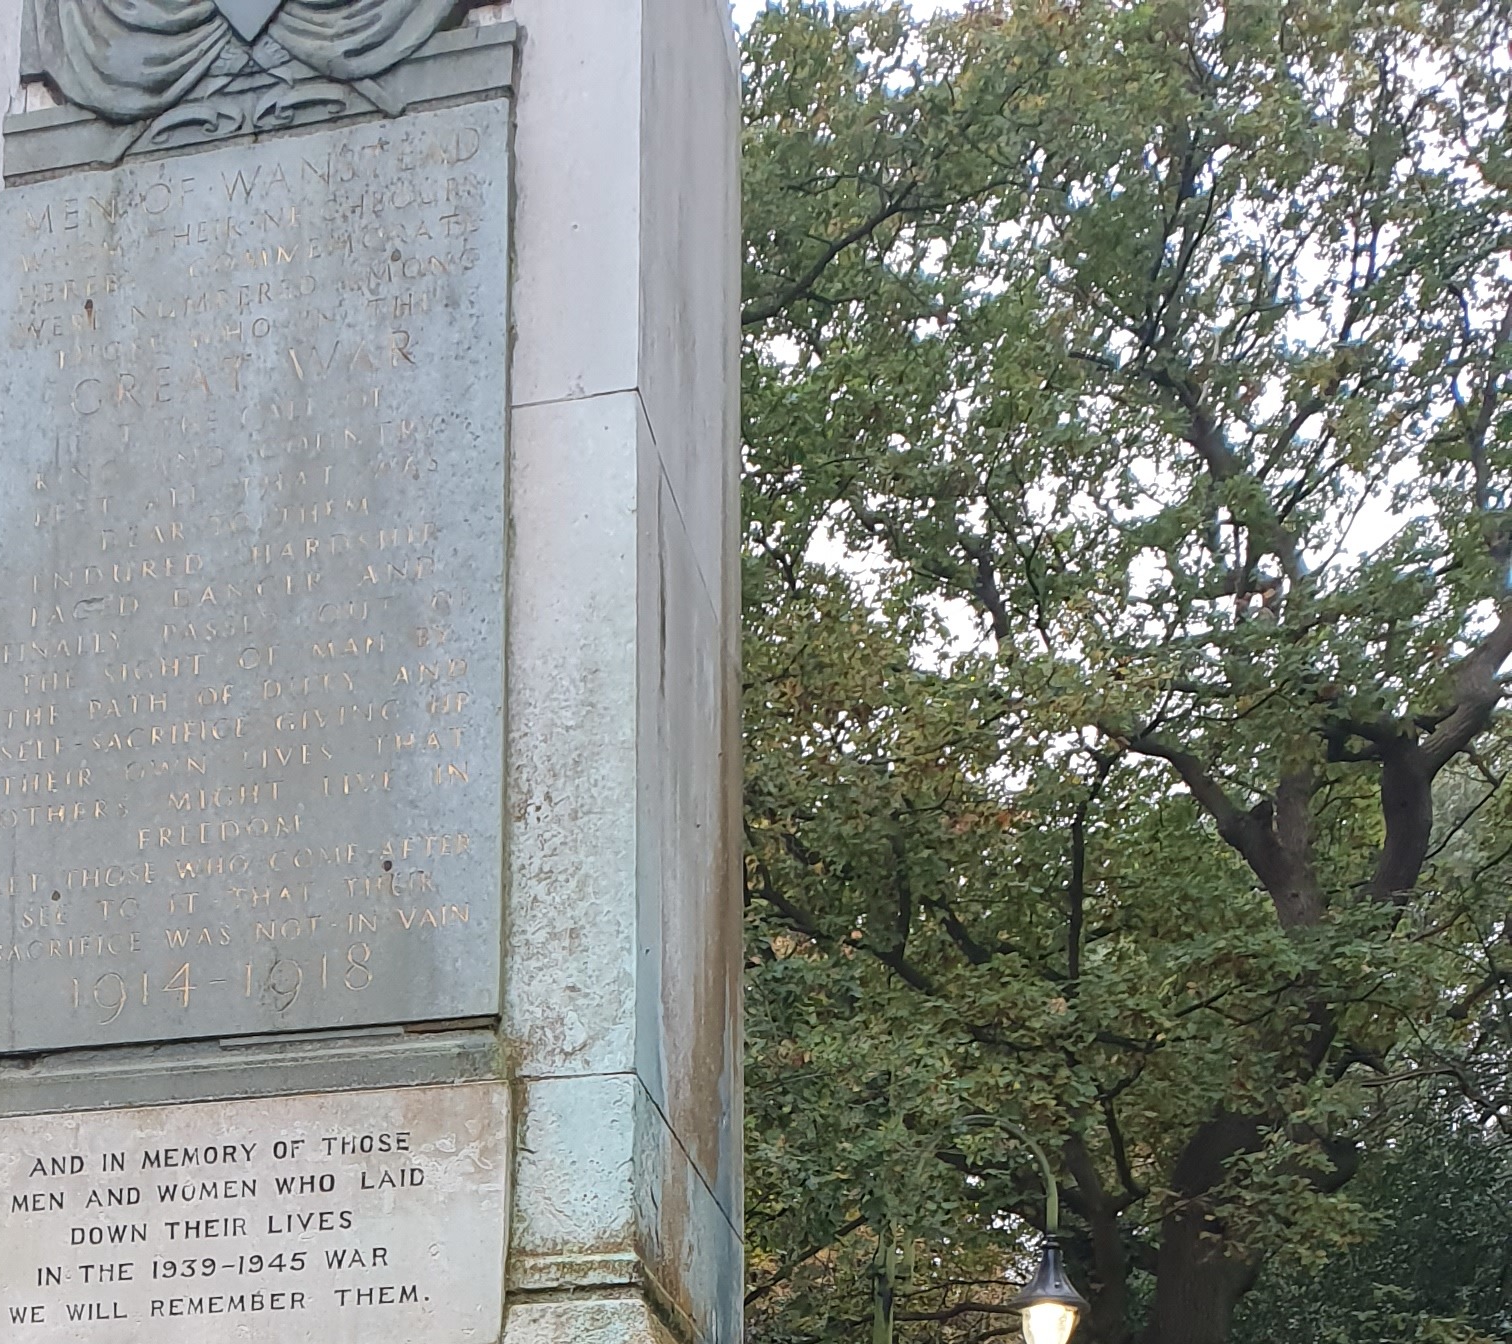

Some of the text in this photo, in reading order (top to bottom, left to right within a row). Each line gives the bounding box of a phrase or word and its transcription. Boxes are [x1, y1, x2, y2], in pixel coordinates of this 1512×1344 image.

[166, 926, 230, 949] WAS
[396, 904, 470, 930] VAIN
[71, 942, 373, 1025] 1914-1918
[29, 1131, 411, 1178] AND IN MEMORY OF THOSE
[11, 1167, 425, 1214] MEN AND WOMEN WHO LAID
[70, 1210, 353, 1246] DOWN THEIR LIVES
[37, 1247, 389, 1287] IN THE 1939-1945 WAR
[8, 1284, 430, 1324] WE WILL REMEMBER THEM.
